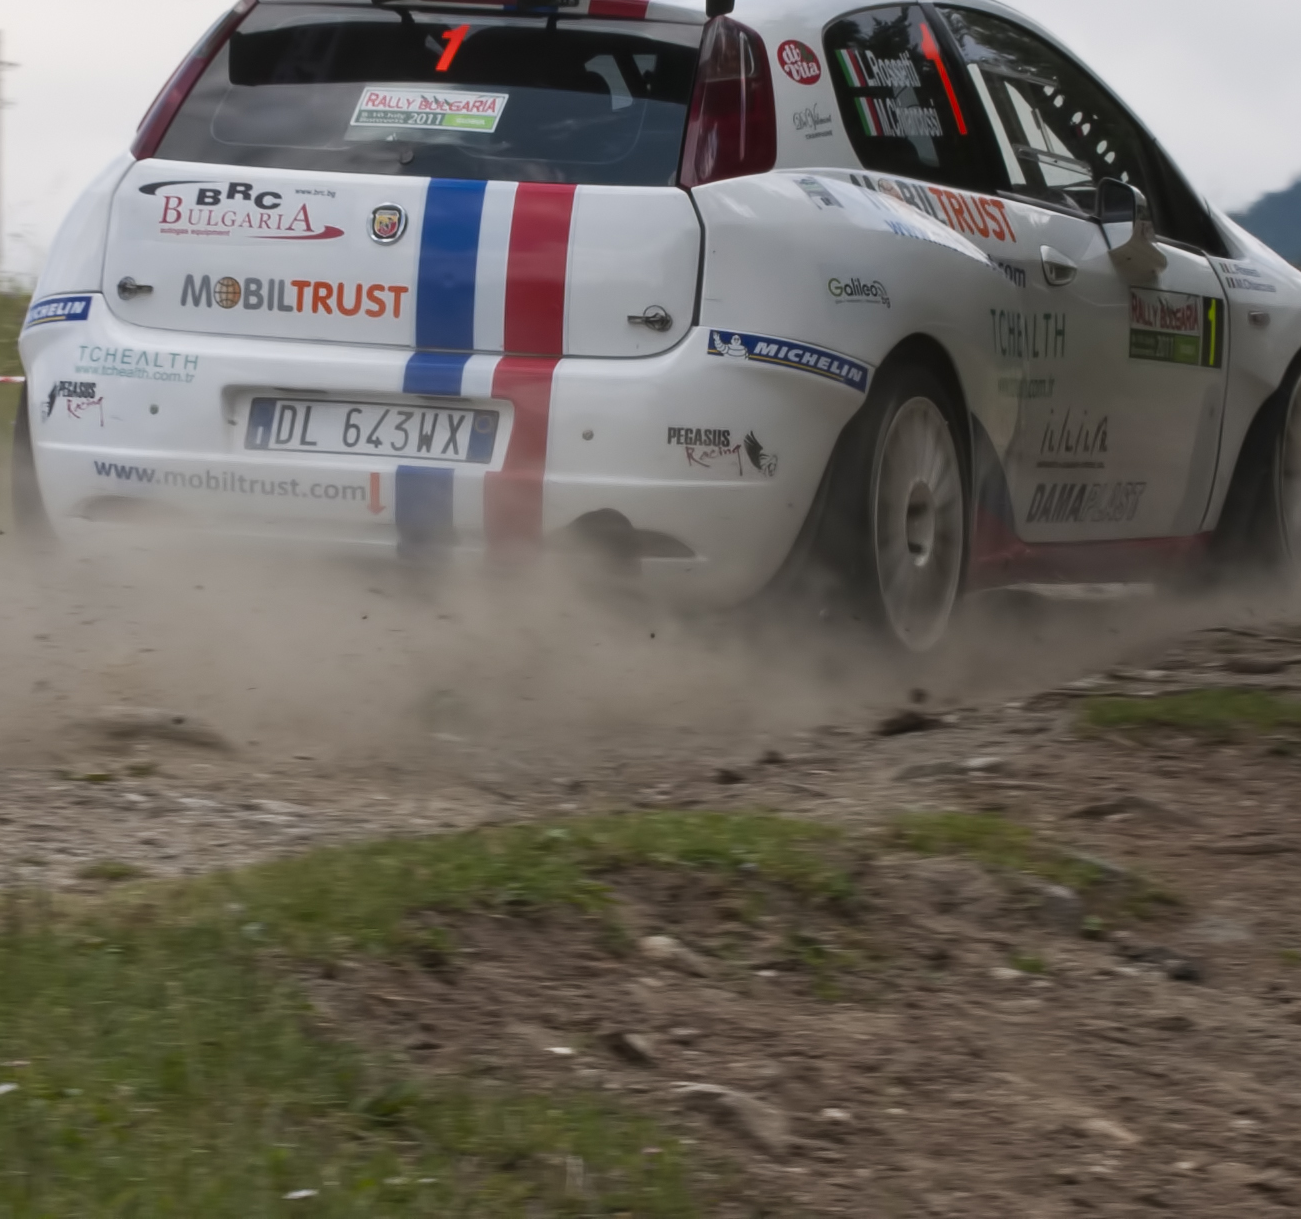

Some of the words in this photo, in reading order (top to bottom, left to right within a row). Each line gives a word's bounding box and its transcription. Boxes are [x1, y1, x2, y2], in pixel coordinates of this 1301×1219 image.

[435, 24, 470, 71] 1
[919, 23, 967, 135] 1
[366, 92, 415, 110] RALLY
[418, 97, 497, 114] BULGARIA
[408, 112, 442, 125] 2011
[196, 182, 283, 210] BRC
[159, 195, 315, 233] BULGARIA
[180, 274, 409, 319] MOBILTRUST
[828, 278, 879, 297] Galileo
[1208, 298, 1216, 366] 1
[79, 346, 199, 370] TCHEALTH
[753, 341, 863, 382] MICHELIN
[57, 381, 97, 399] PEGASUS
[275, 404, 317, 447] DL
[343, 408, 465, 455] 643WX
[667, 427, 731, 447] PEGASUS
[685, 444, 743, 477] Racing
[93, 460, 367, 502] www.mobiltrust.com
